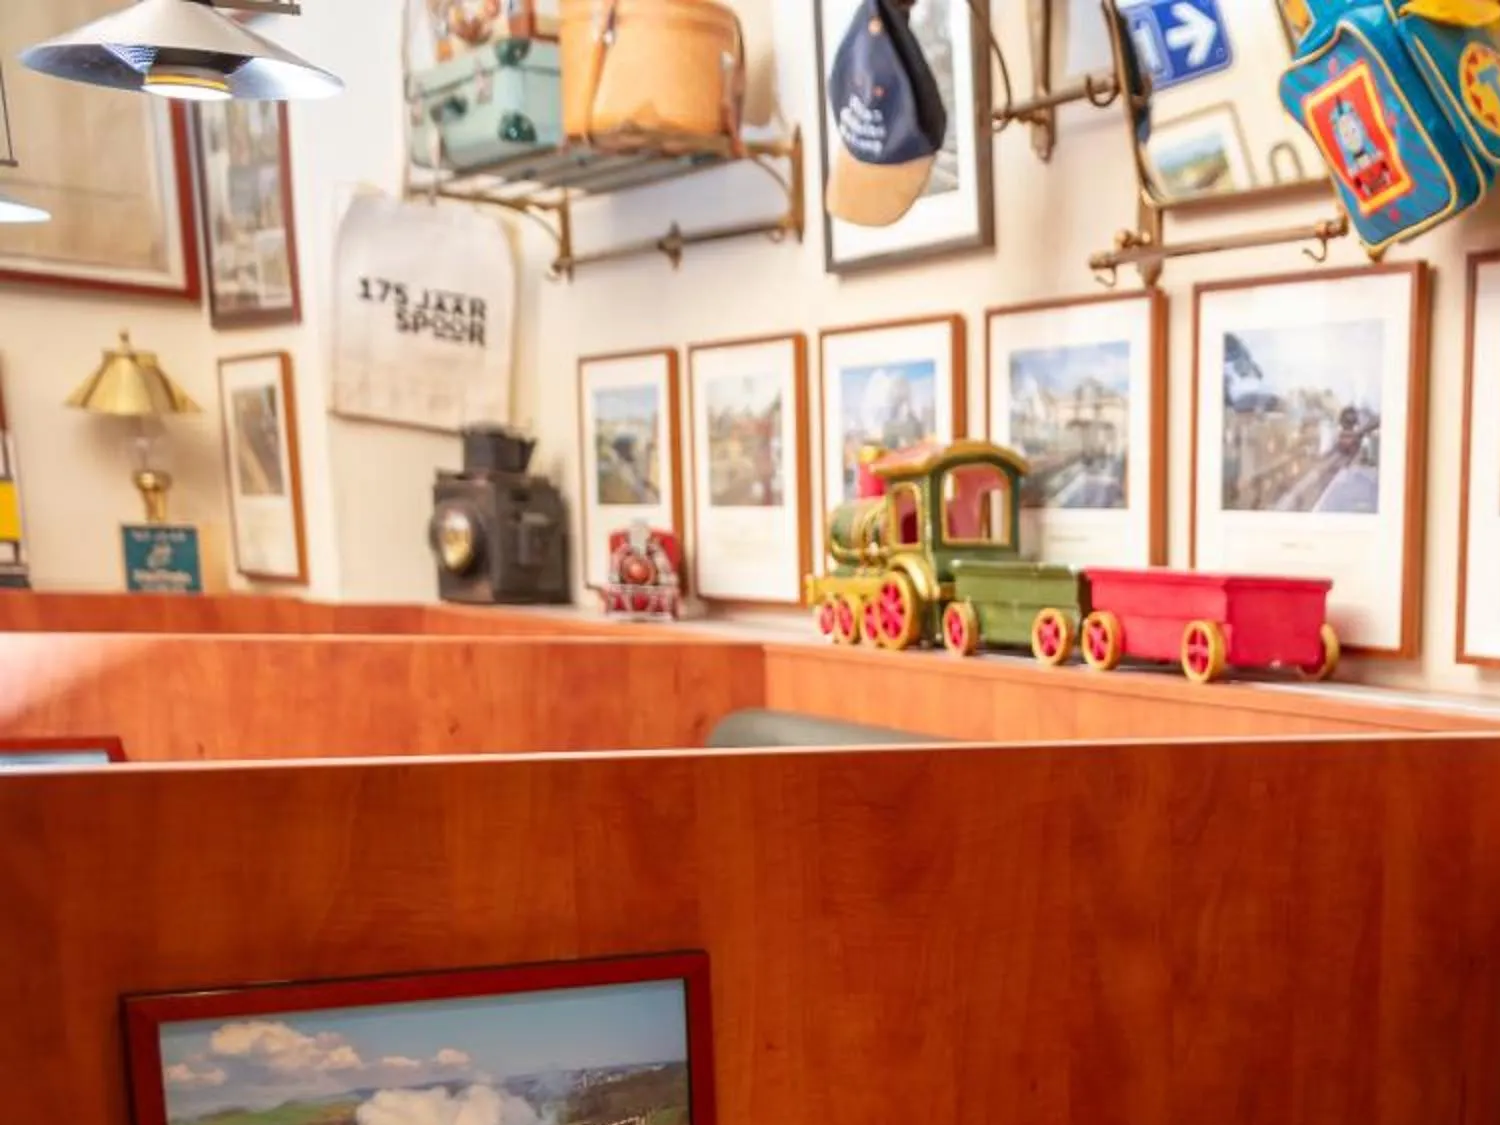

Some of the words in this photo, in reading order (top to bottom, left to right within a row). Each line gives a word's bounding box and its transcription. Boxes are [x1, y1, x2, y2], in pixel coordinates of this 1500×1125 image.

[358, 277, 408, 305] 175
[416, 288, 486, 320] JAAR
[396, 307, 486, 346] SPOOR
